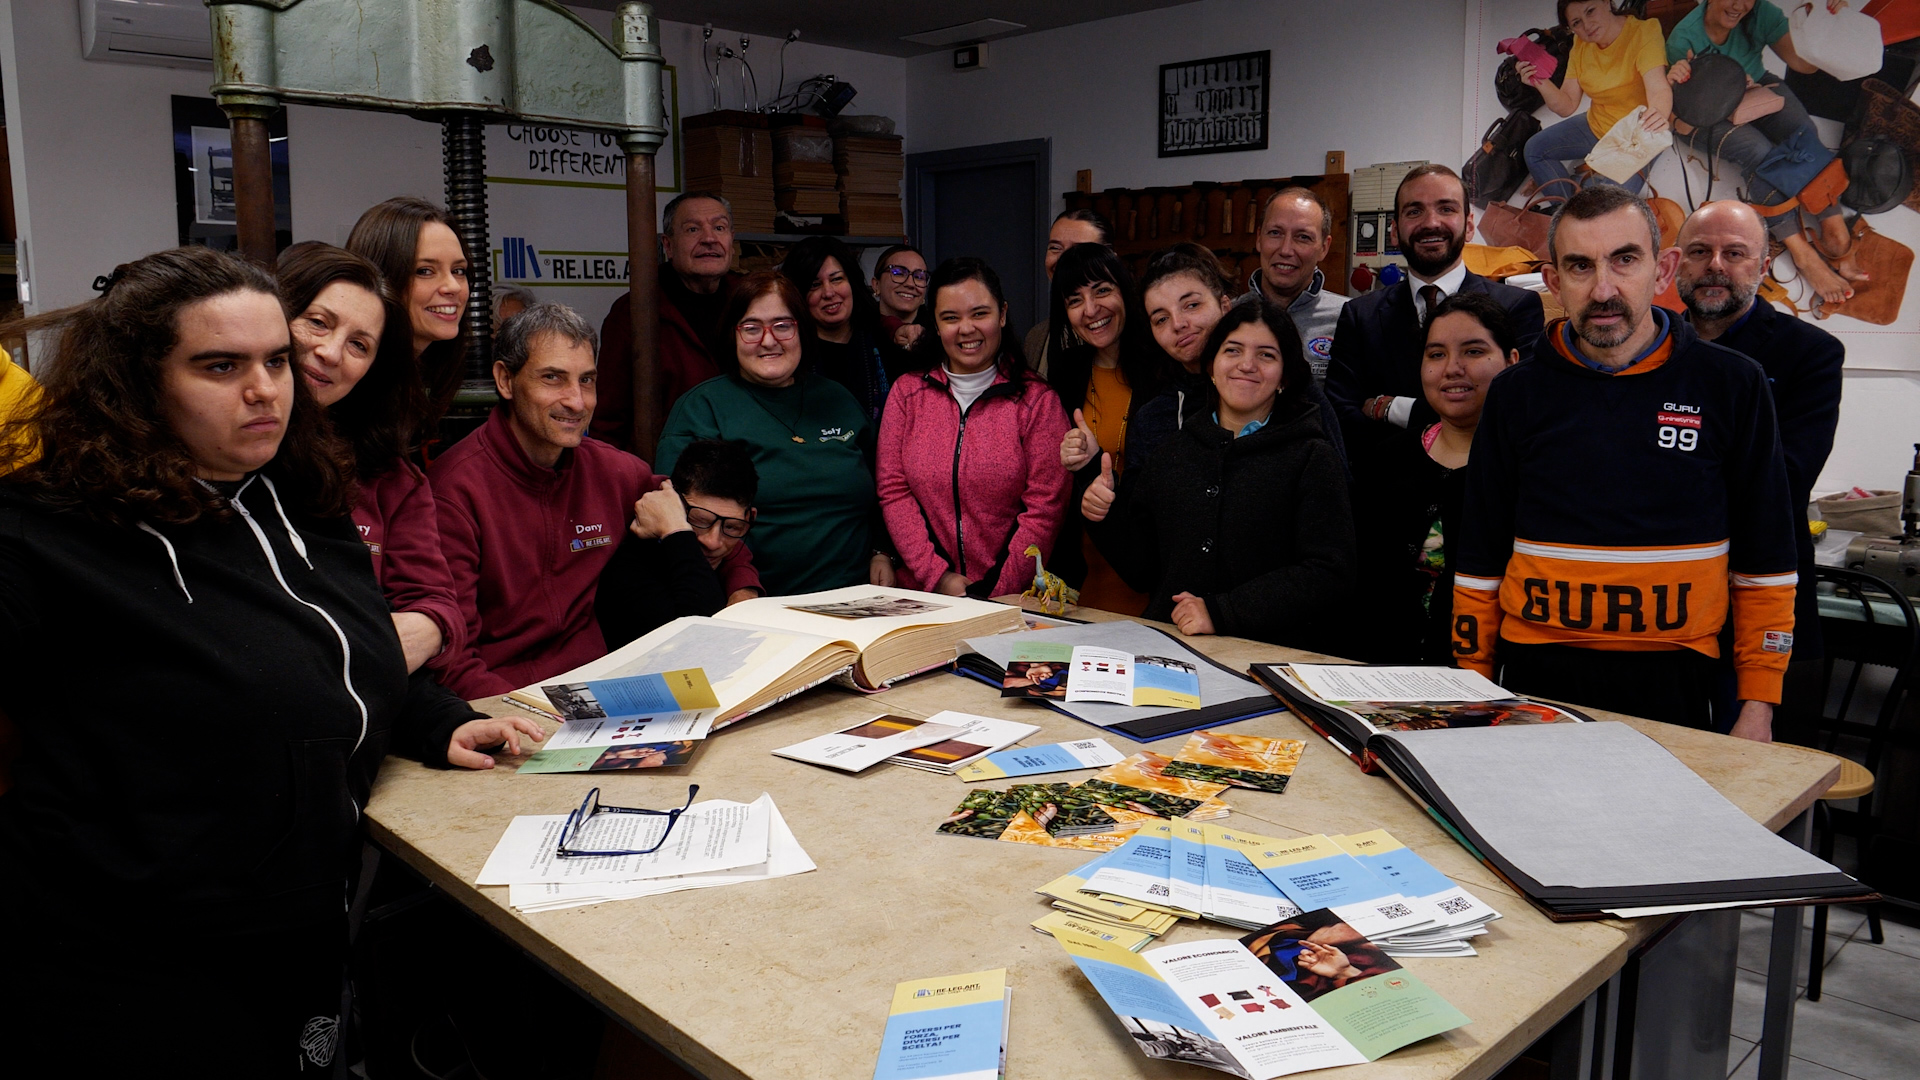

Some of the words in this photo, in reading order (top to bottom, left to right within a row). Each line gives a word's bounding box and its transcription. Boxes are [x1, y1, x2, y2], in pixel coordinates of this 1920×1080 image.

[508, 125, 581, 146] CHOOSE
[529, 148, 626, 177] DIFFERENT
[1663, 402, 1700, 414] GURU
[1657, 426, 1699, 451] 99
[575, 523, 603, 535] Dany
[1521, 578, 1692, 633] GURU
[1289, 873, 1318, 881] DIVERSI
[1296, 880, 1326, 888] DIVERSI
[1162, 955, 1192, 964] VALORE
[1192, 949, 1239, 959] ECONOMICO
[905, 1026, 942, 1035] DIVERSI
[944, 1023, 961, 1031] PER
[1235, 1031, 1268, 1041] VALORE
[1269, 1024, 1319, 1035] AMBIENTALE
[901, 1041, 942, 1051] SCELTA!
[902, 1037, 940, 1046] DIVERSI
